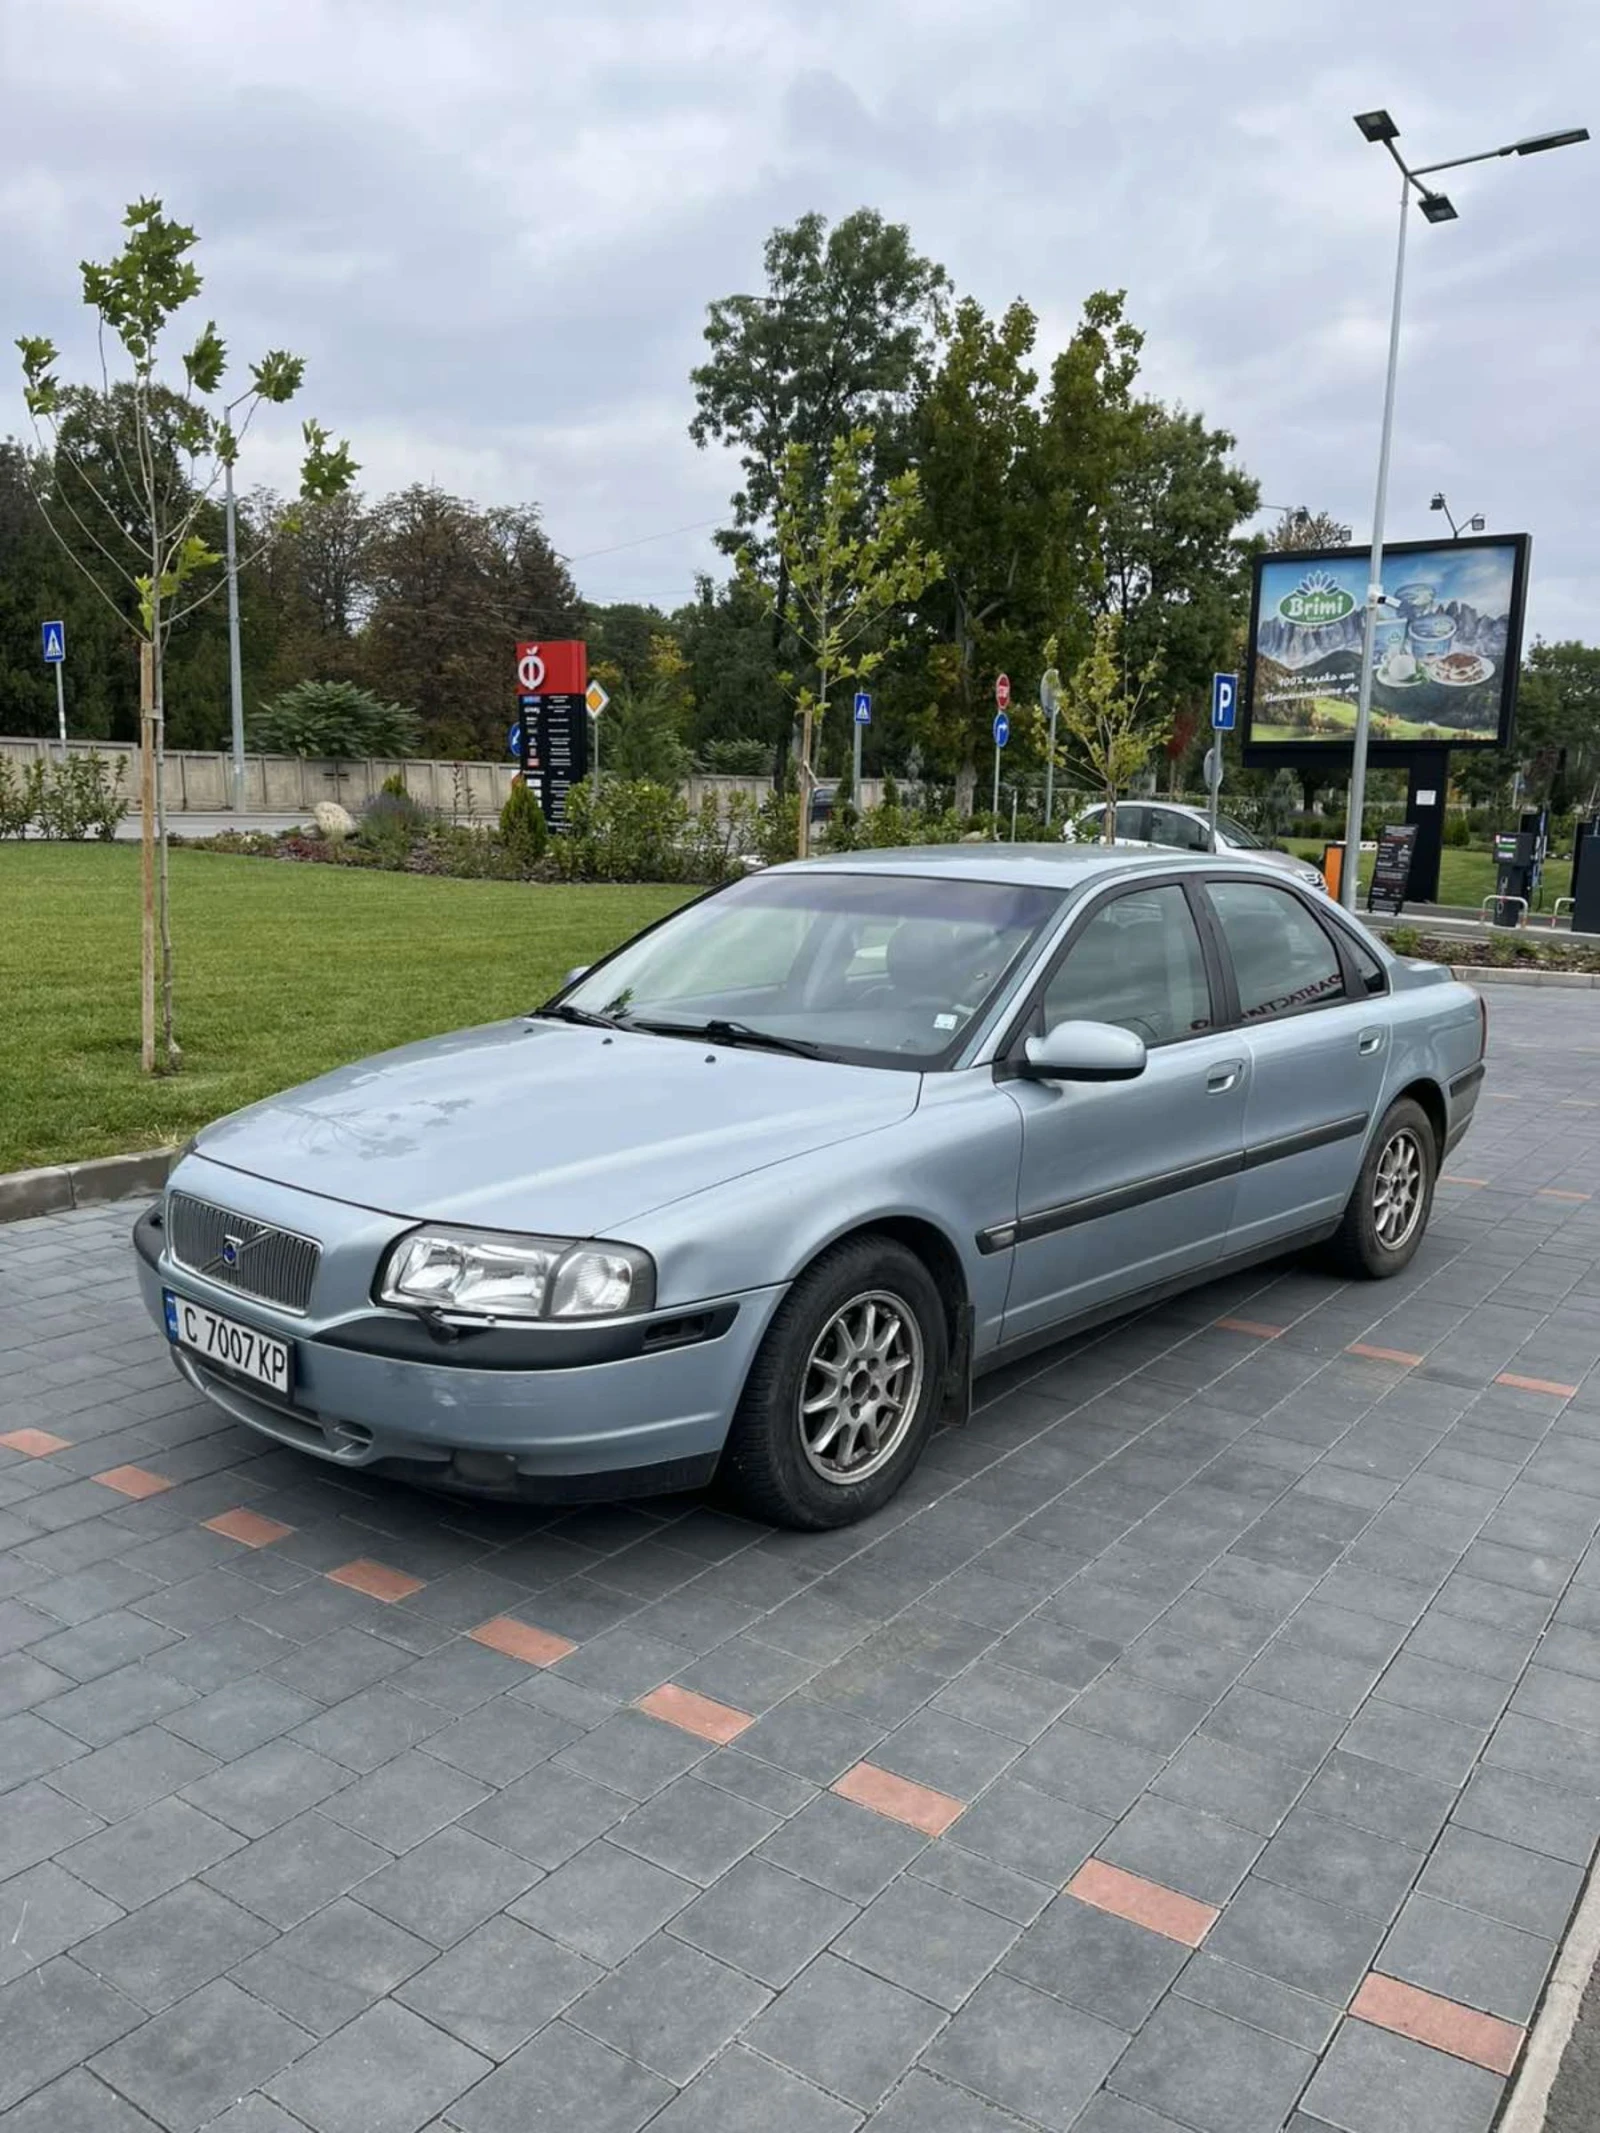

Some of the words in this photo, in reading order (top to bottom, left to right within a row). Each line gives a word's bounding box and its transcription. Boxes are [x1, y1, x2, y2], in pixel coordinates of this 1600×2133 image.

[1288, 595, 1344, 617] Brimi
[1219, 682, 1232, 722] P
[184, 1306, 198, 1343] C
